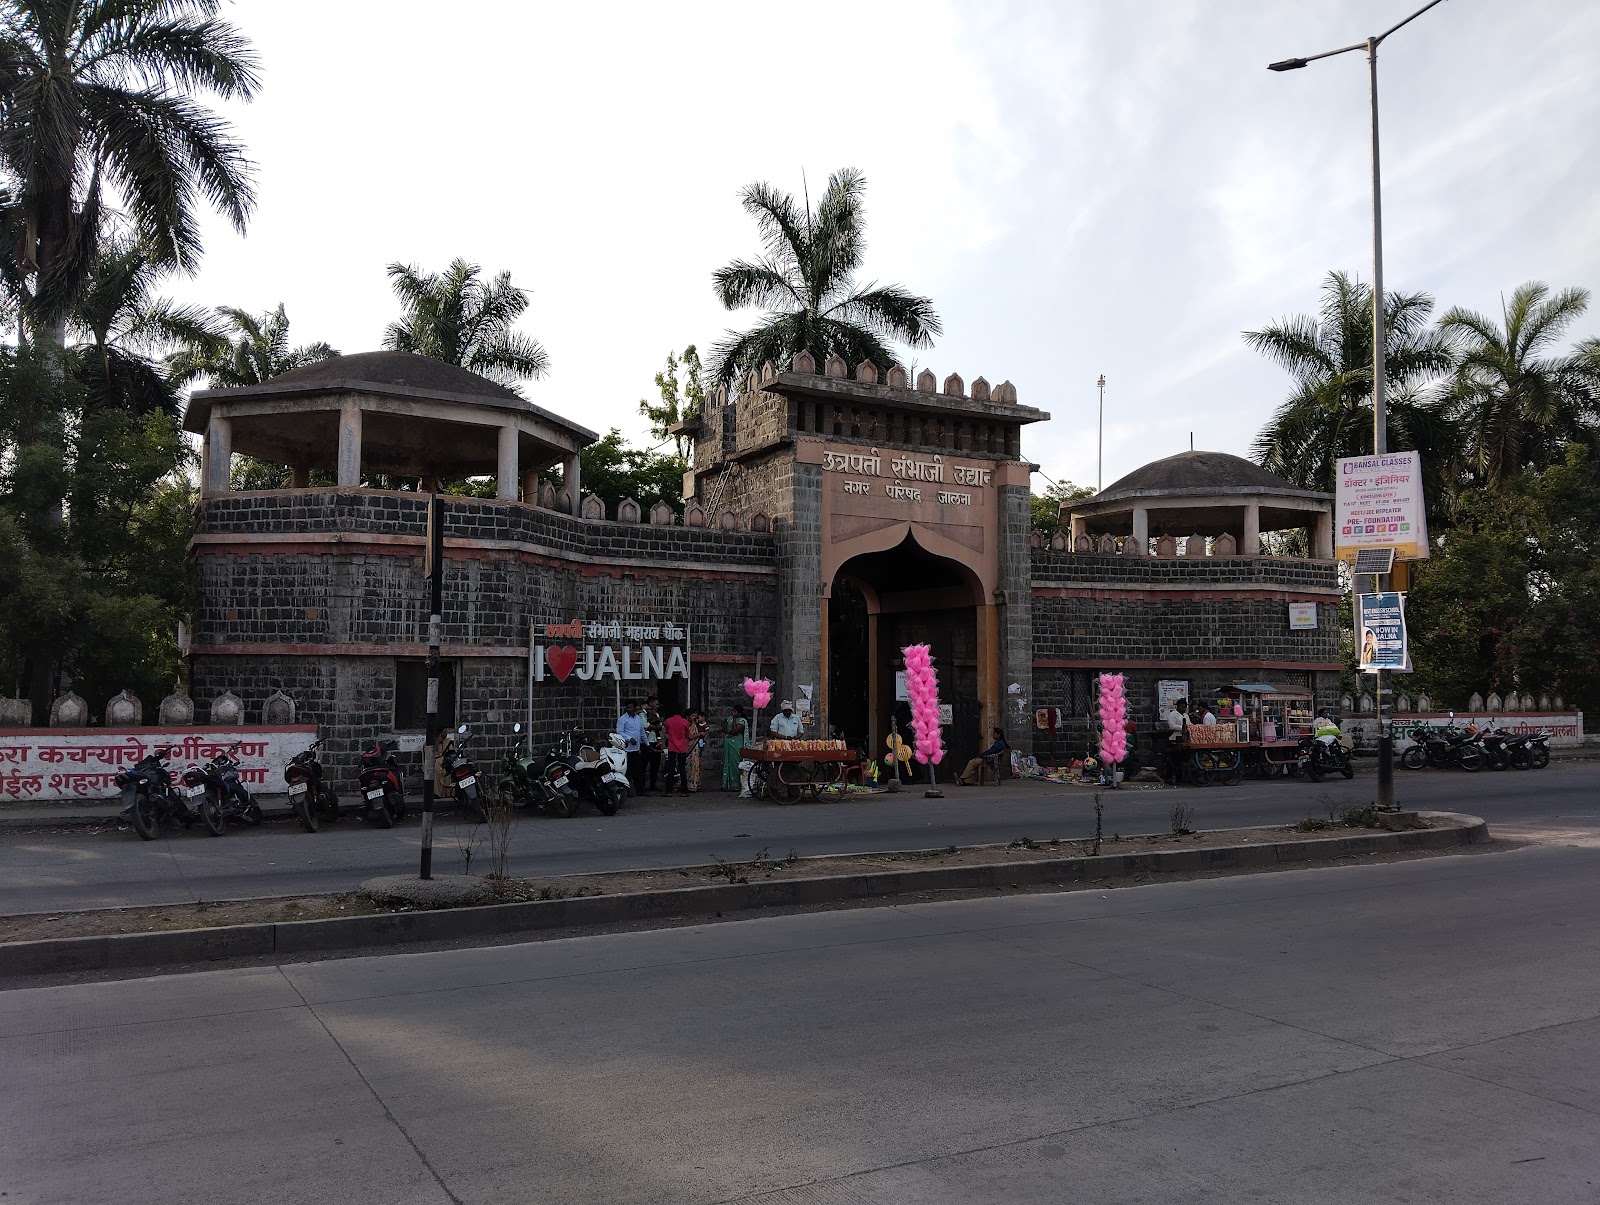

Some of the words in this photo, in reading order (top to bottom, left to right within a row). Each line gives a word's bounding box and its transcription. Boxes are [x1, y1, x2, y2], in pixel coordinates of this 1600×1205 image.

[891, 455, 944, 483] संभाजी
[1354, 459, 1380, 469] BANSAL
[1381, 457, 1412, 466] CLASSES
[1344, 478, 1367, 488] डॉक्टर
[1375, 475, 1410, 486] इंजिनियर
[844, 480, 870, 495] नगर
[938, 490, 971, 506] जालना
[1364, 516, 1405, 525] FOUNDATION
[546, 618, 583, 639] छत्रपती
[587, 620, 621, 639] संभाजी
[1375, 626, 1391, 634] NOW
[535, 645, 544, 682] I
[576, 645, 688, 681] JALNA
